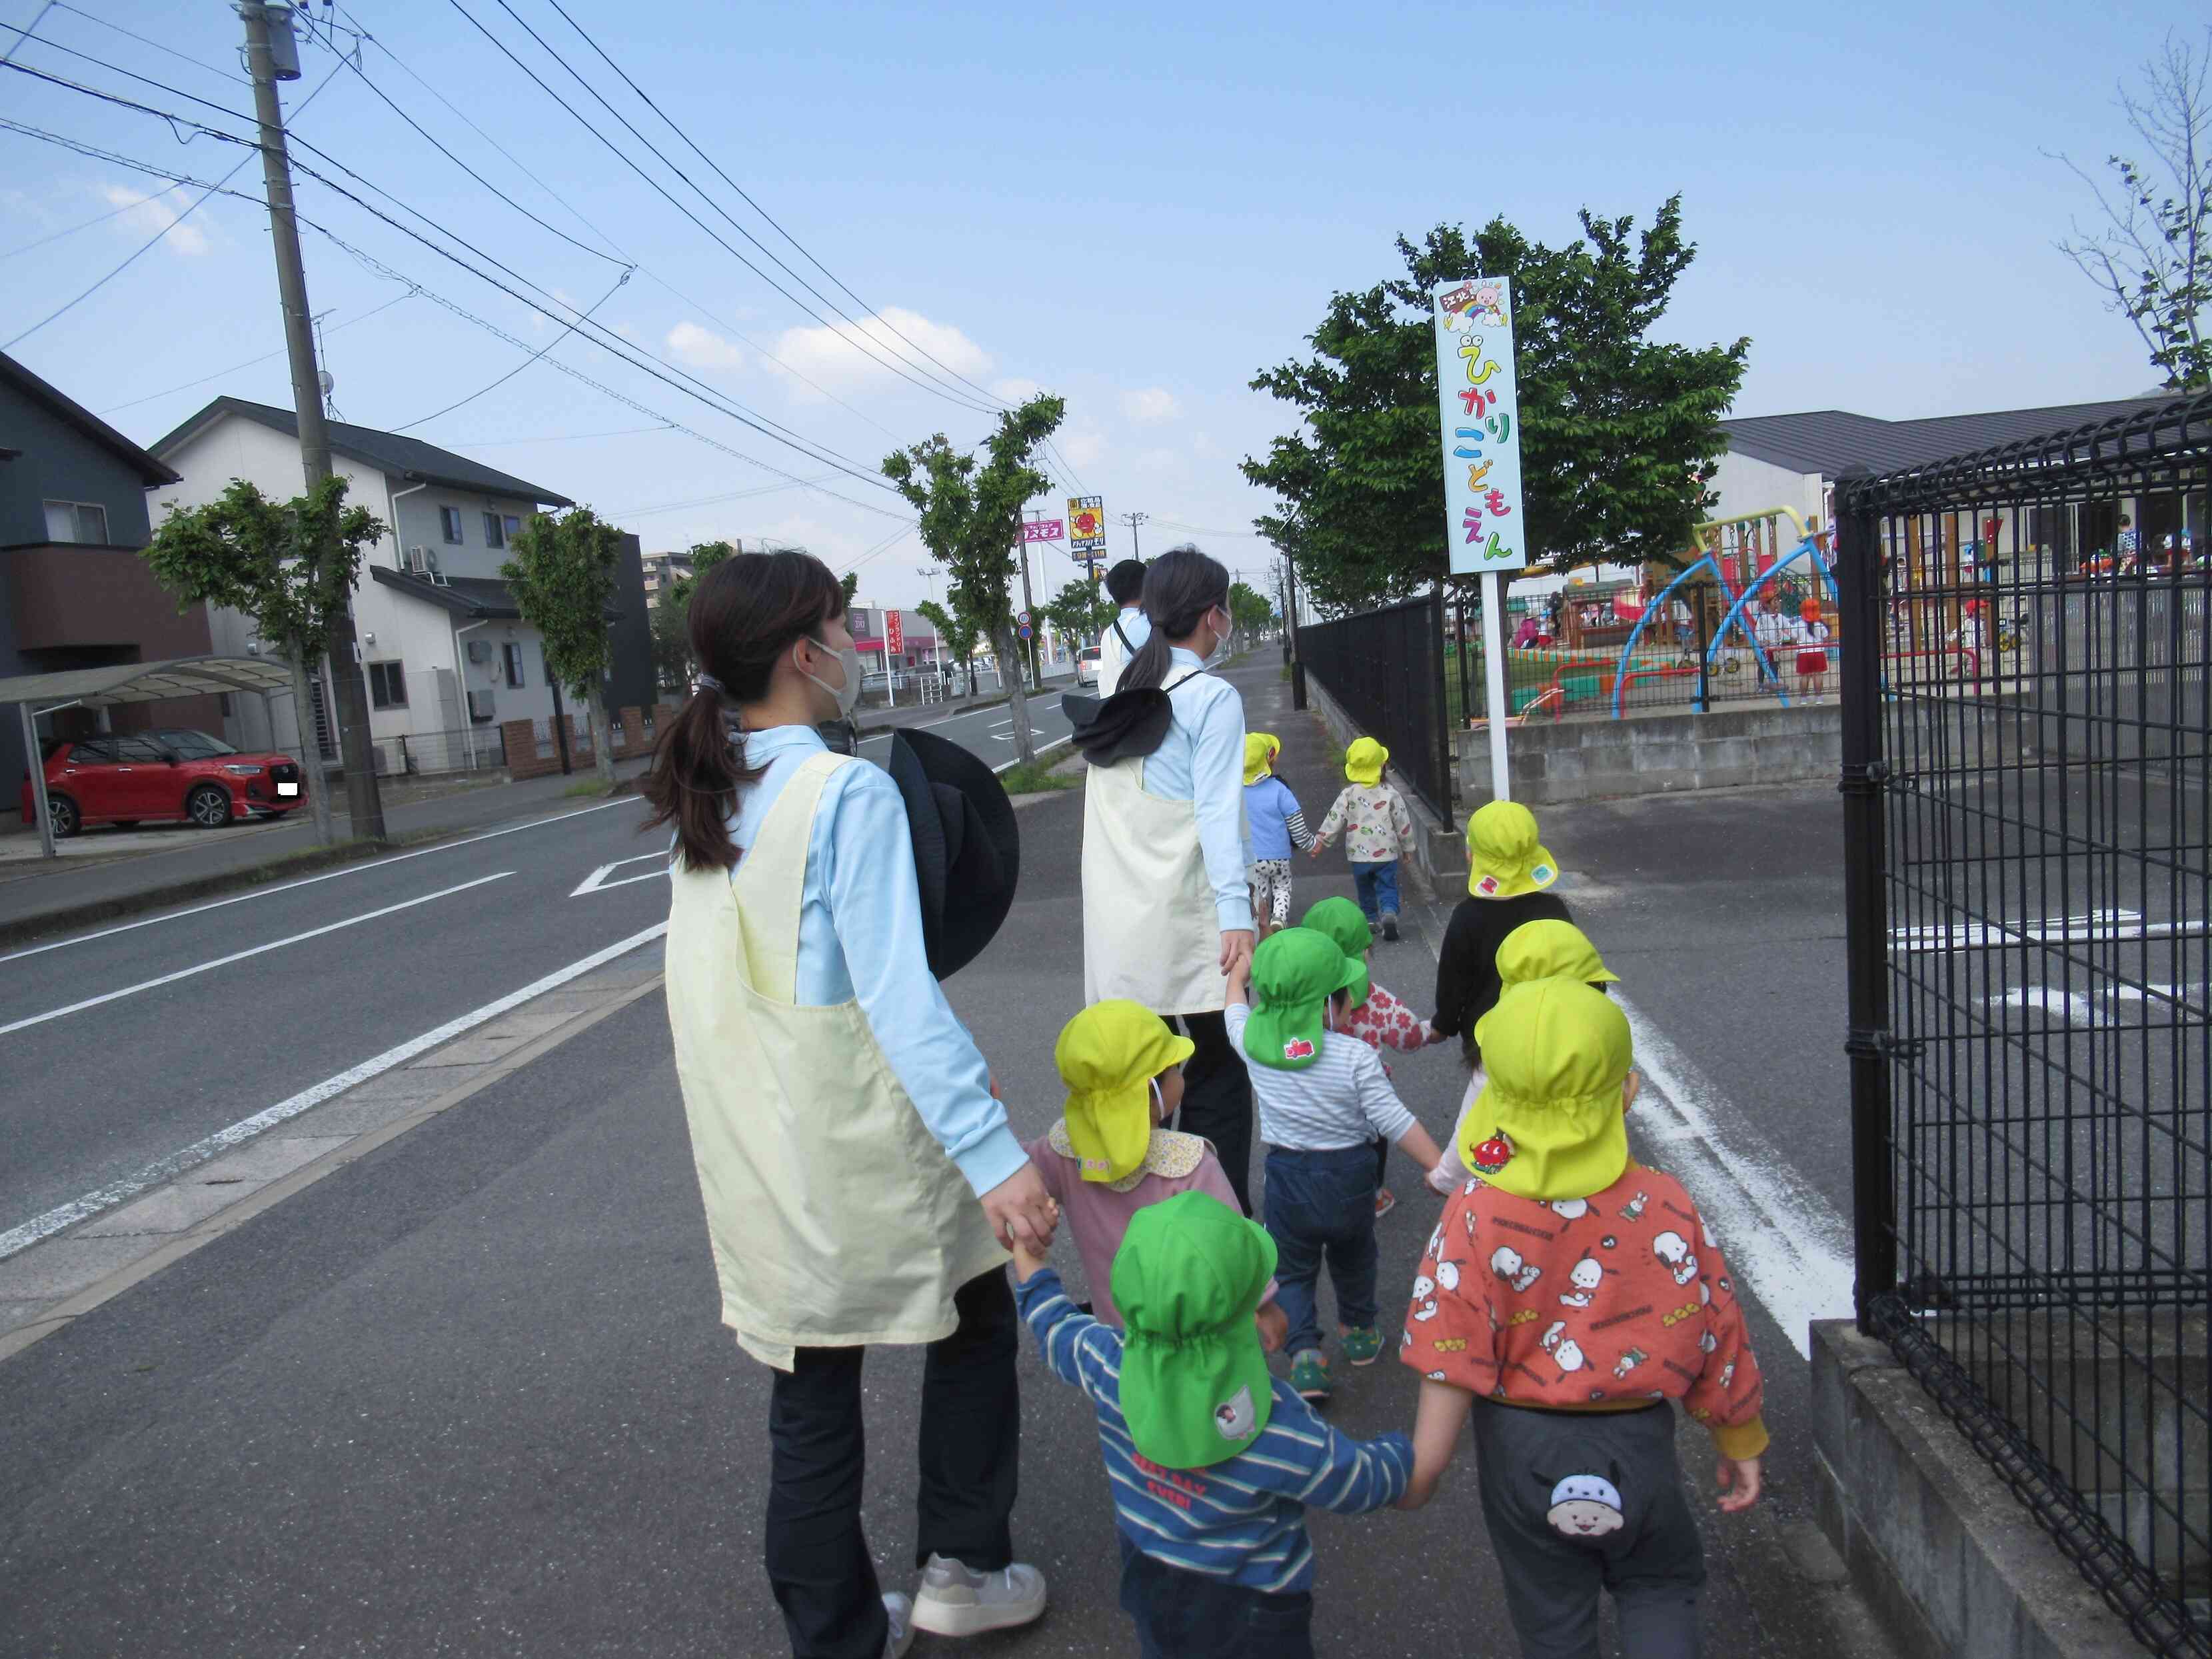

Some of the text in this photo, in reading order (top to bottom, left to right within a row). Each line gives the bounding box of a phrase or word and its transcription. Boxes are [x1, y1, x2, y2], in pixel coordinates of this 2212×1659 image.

[1453, 345, 1513, 561] ひかりこどもえん
